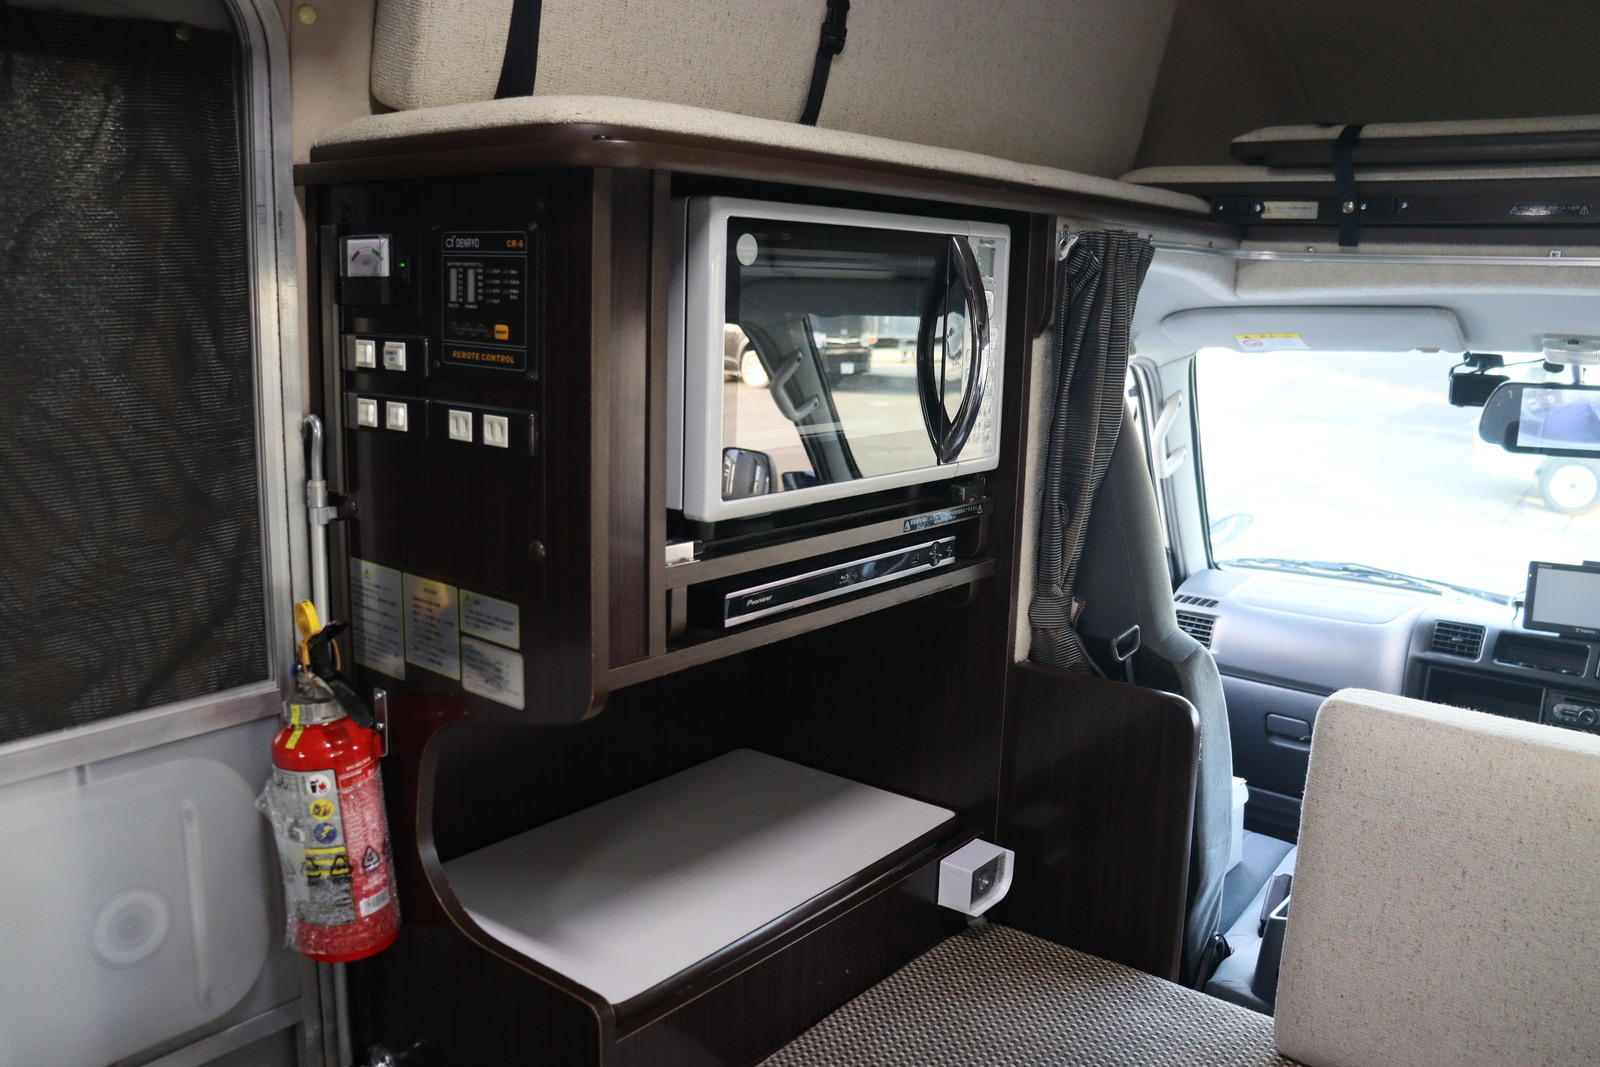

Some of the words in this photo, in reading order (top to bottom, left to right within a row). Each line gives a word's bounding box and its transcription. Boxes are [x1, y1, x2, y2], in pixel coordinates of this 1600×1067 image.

[455, 238, 480, 248] DENRYO
[506, 239, 524, 248] CR-6
[452, 350, 480, 360] REMOTE
[481, 354, 515, 364] CONTROL
[746, 595, 772, 607] Pioneer
